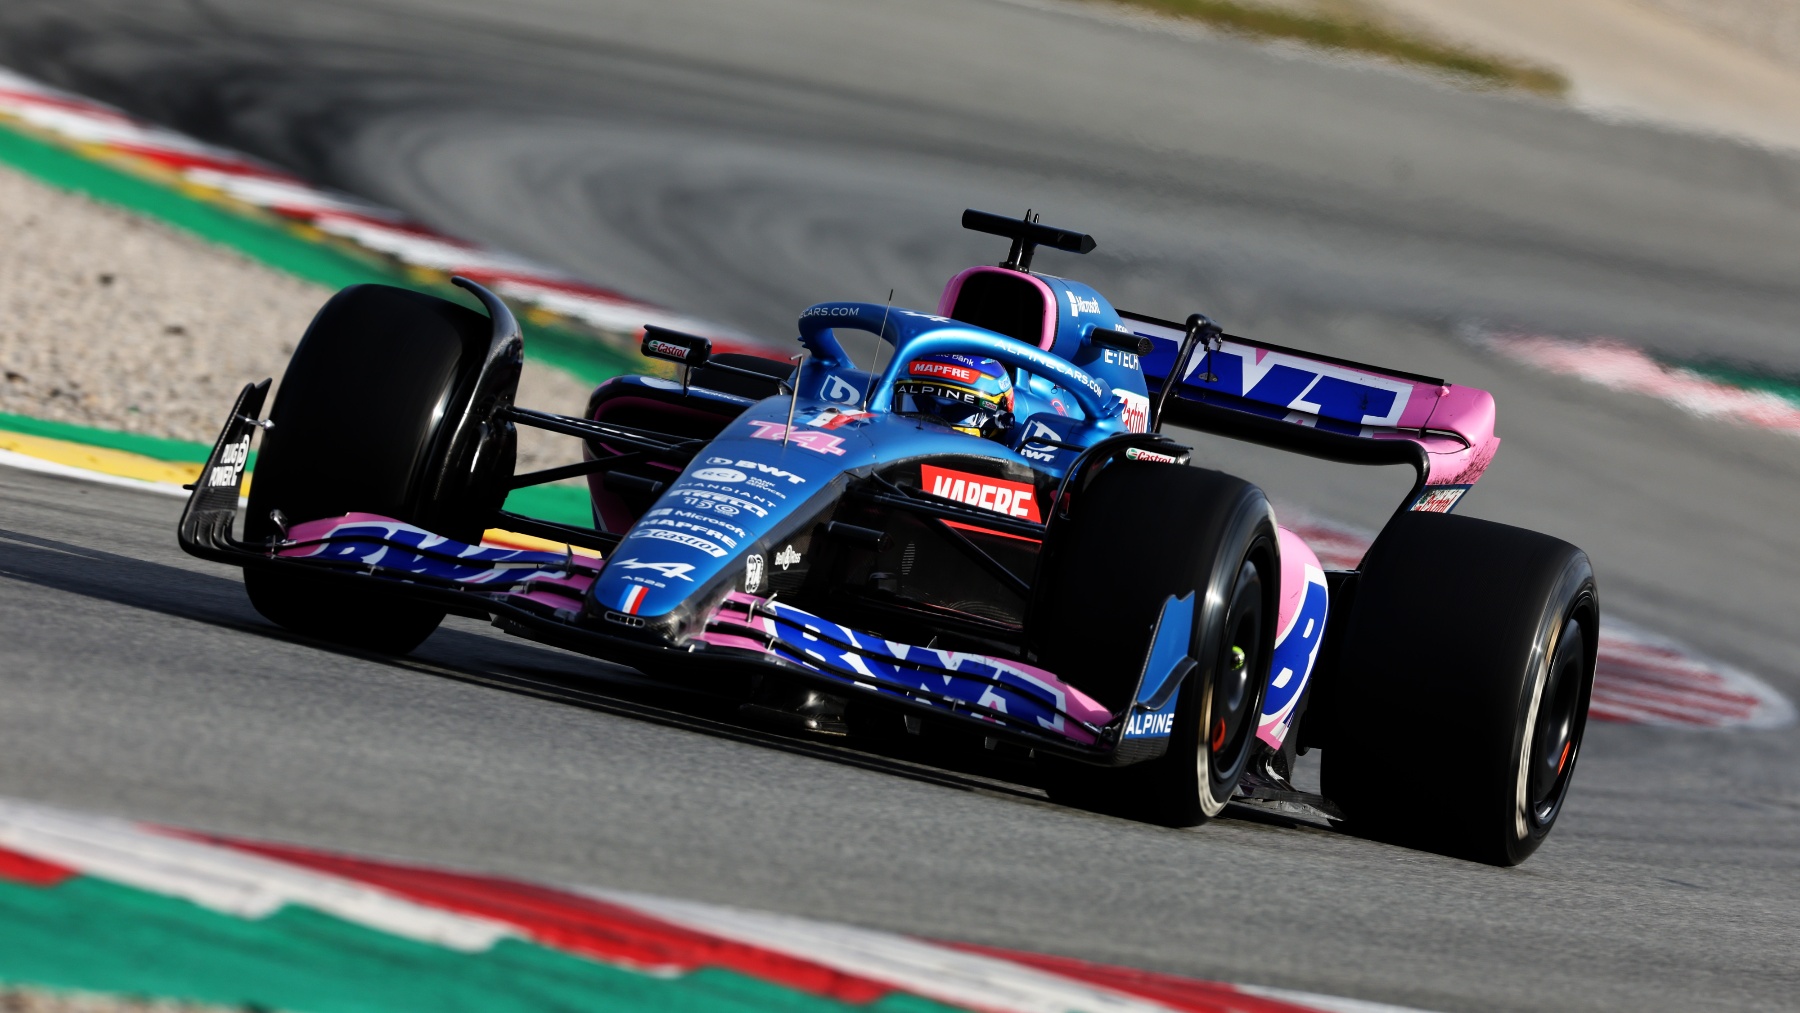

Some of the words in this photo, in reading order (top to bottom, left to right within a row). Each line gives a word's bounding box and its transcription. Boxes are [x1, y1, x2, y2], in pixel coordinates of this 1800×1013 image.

[1075, 296, 1101, 315] Microsoft
[657, 342, 687, 359] Castrol
[1104, 349, 1139, 371] E-TECH
[913, 363, 970, 380] MAPFRE
[994, 339, 1102, 398] ALPINECARS.COM
[897, 385, 975, 404] ALPINE
[748, 419, 847, 456] 14
[735, 460, 806, 485] BWT
[678, 483, 777, 508] MANDIANT
[639, 519, 738, 549] MAPFRE
[674, 510, 746, 539] Microsoft
[653, 529, 721, 554] Castrol
[621, 575, 667, 589] A522
[760, 600, 1067, 735] BWT
[1125, 712, 1175, 735] ALPINE
